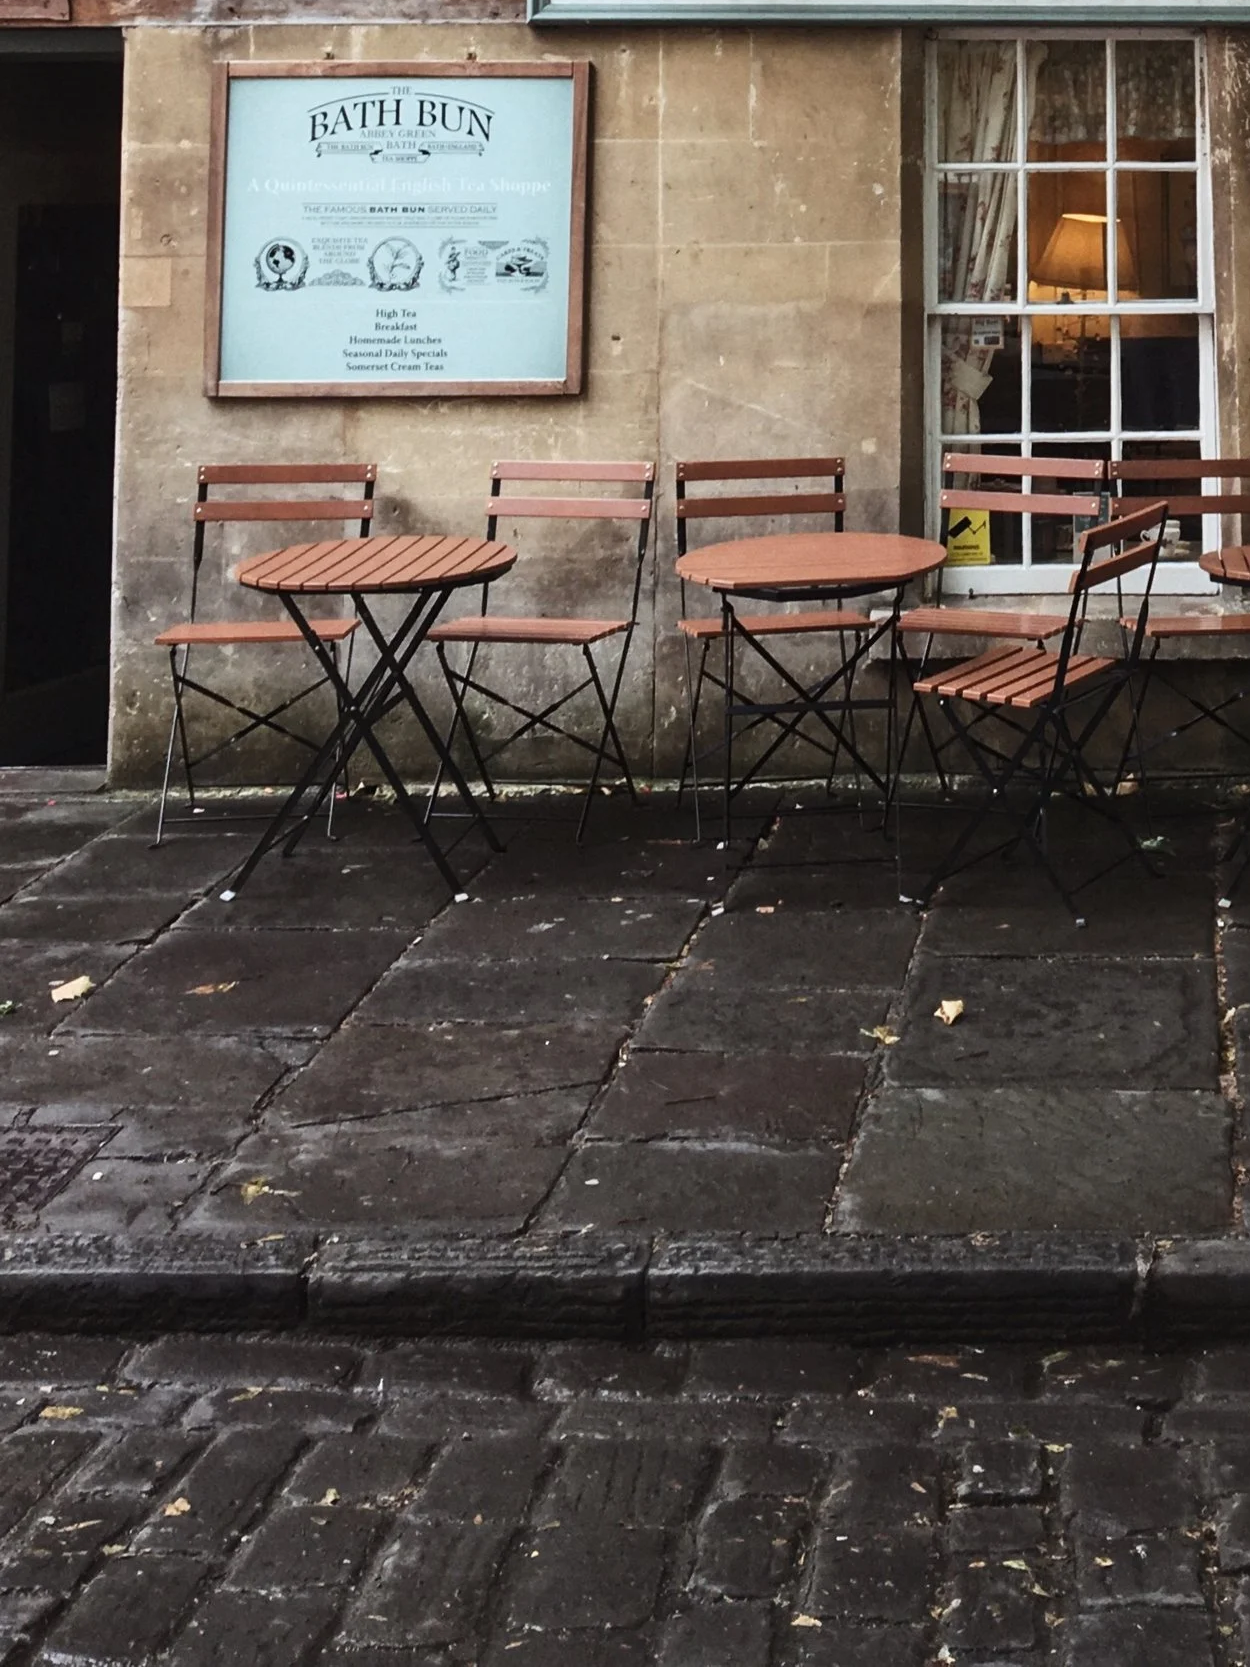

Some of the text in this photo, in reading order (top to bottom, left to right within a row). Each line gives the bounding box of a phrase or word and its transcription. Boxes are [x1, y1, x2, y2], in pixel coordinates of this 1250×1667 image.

[390, 86, 412, 95] THE
[308, 98, 493, 143] BATH BUN
[359, 130, 436, 138] ABBEY GREEN
[386, 141, 417, 150] BATH
[247, 178, 259, 192] A
[455, 178, 485, 192] Tea
[489, 177, 552, 196] Shoppe
[427, 205, 467, 213] SERVED
[470, 205, 498, 213] DAILY
[376, 309, 417, 319] High Tea
[375, 322, 417, 331] Breakfast
[349, 335, 442, 344] Homemade Lunches
[342, 349, 448, 359] Seasonal Daily Specials
[346, 362, 444, 371] Somerset Cream Teas
